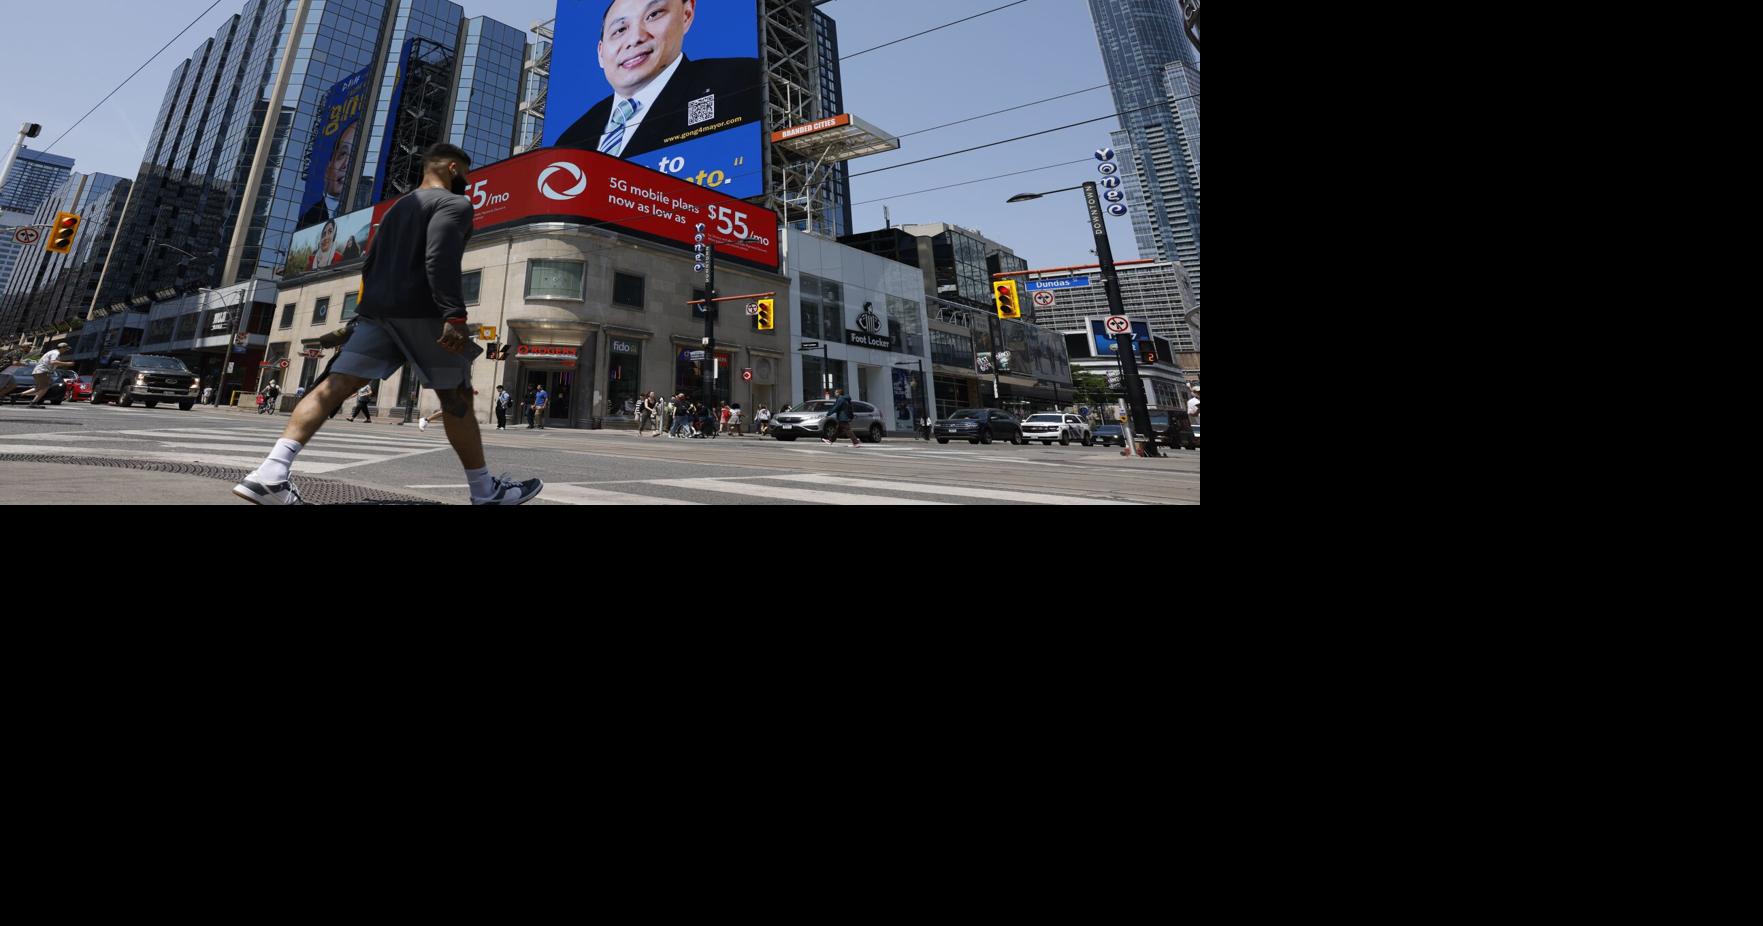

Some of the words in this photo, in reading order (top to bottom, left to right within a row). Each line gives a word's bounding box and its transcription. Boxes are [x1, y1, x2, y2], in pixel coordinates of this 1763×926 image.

[663, 116, 742, 143] www.gong4mayor.com
[813, 119, 836, 130] CITIES
[658, 156, 685, 174] to
[609, 177, 627, 192] 5G
[630, 188, 670, 205] mobile
[672, 198, 700, 214] plans
[608, 195, 636, 209] now
[637, 203, 650, 214] as
[652, 204, 673, 220] low
[674, 214, 687, 224] as
[1084, 185, 1103, 235] DOWNTOWN
[1036, 279, 1070, 289] Dundas
[613, 341, 630, 353] fido
[851, 332, 867, 345] Foot
[868, 335, 890, 348] Locker
[1148, 353, 1154, 362] 2
